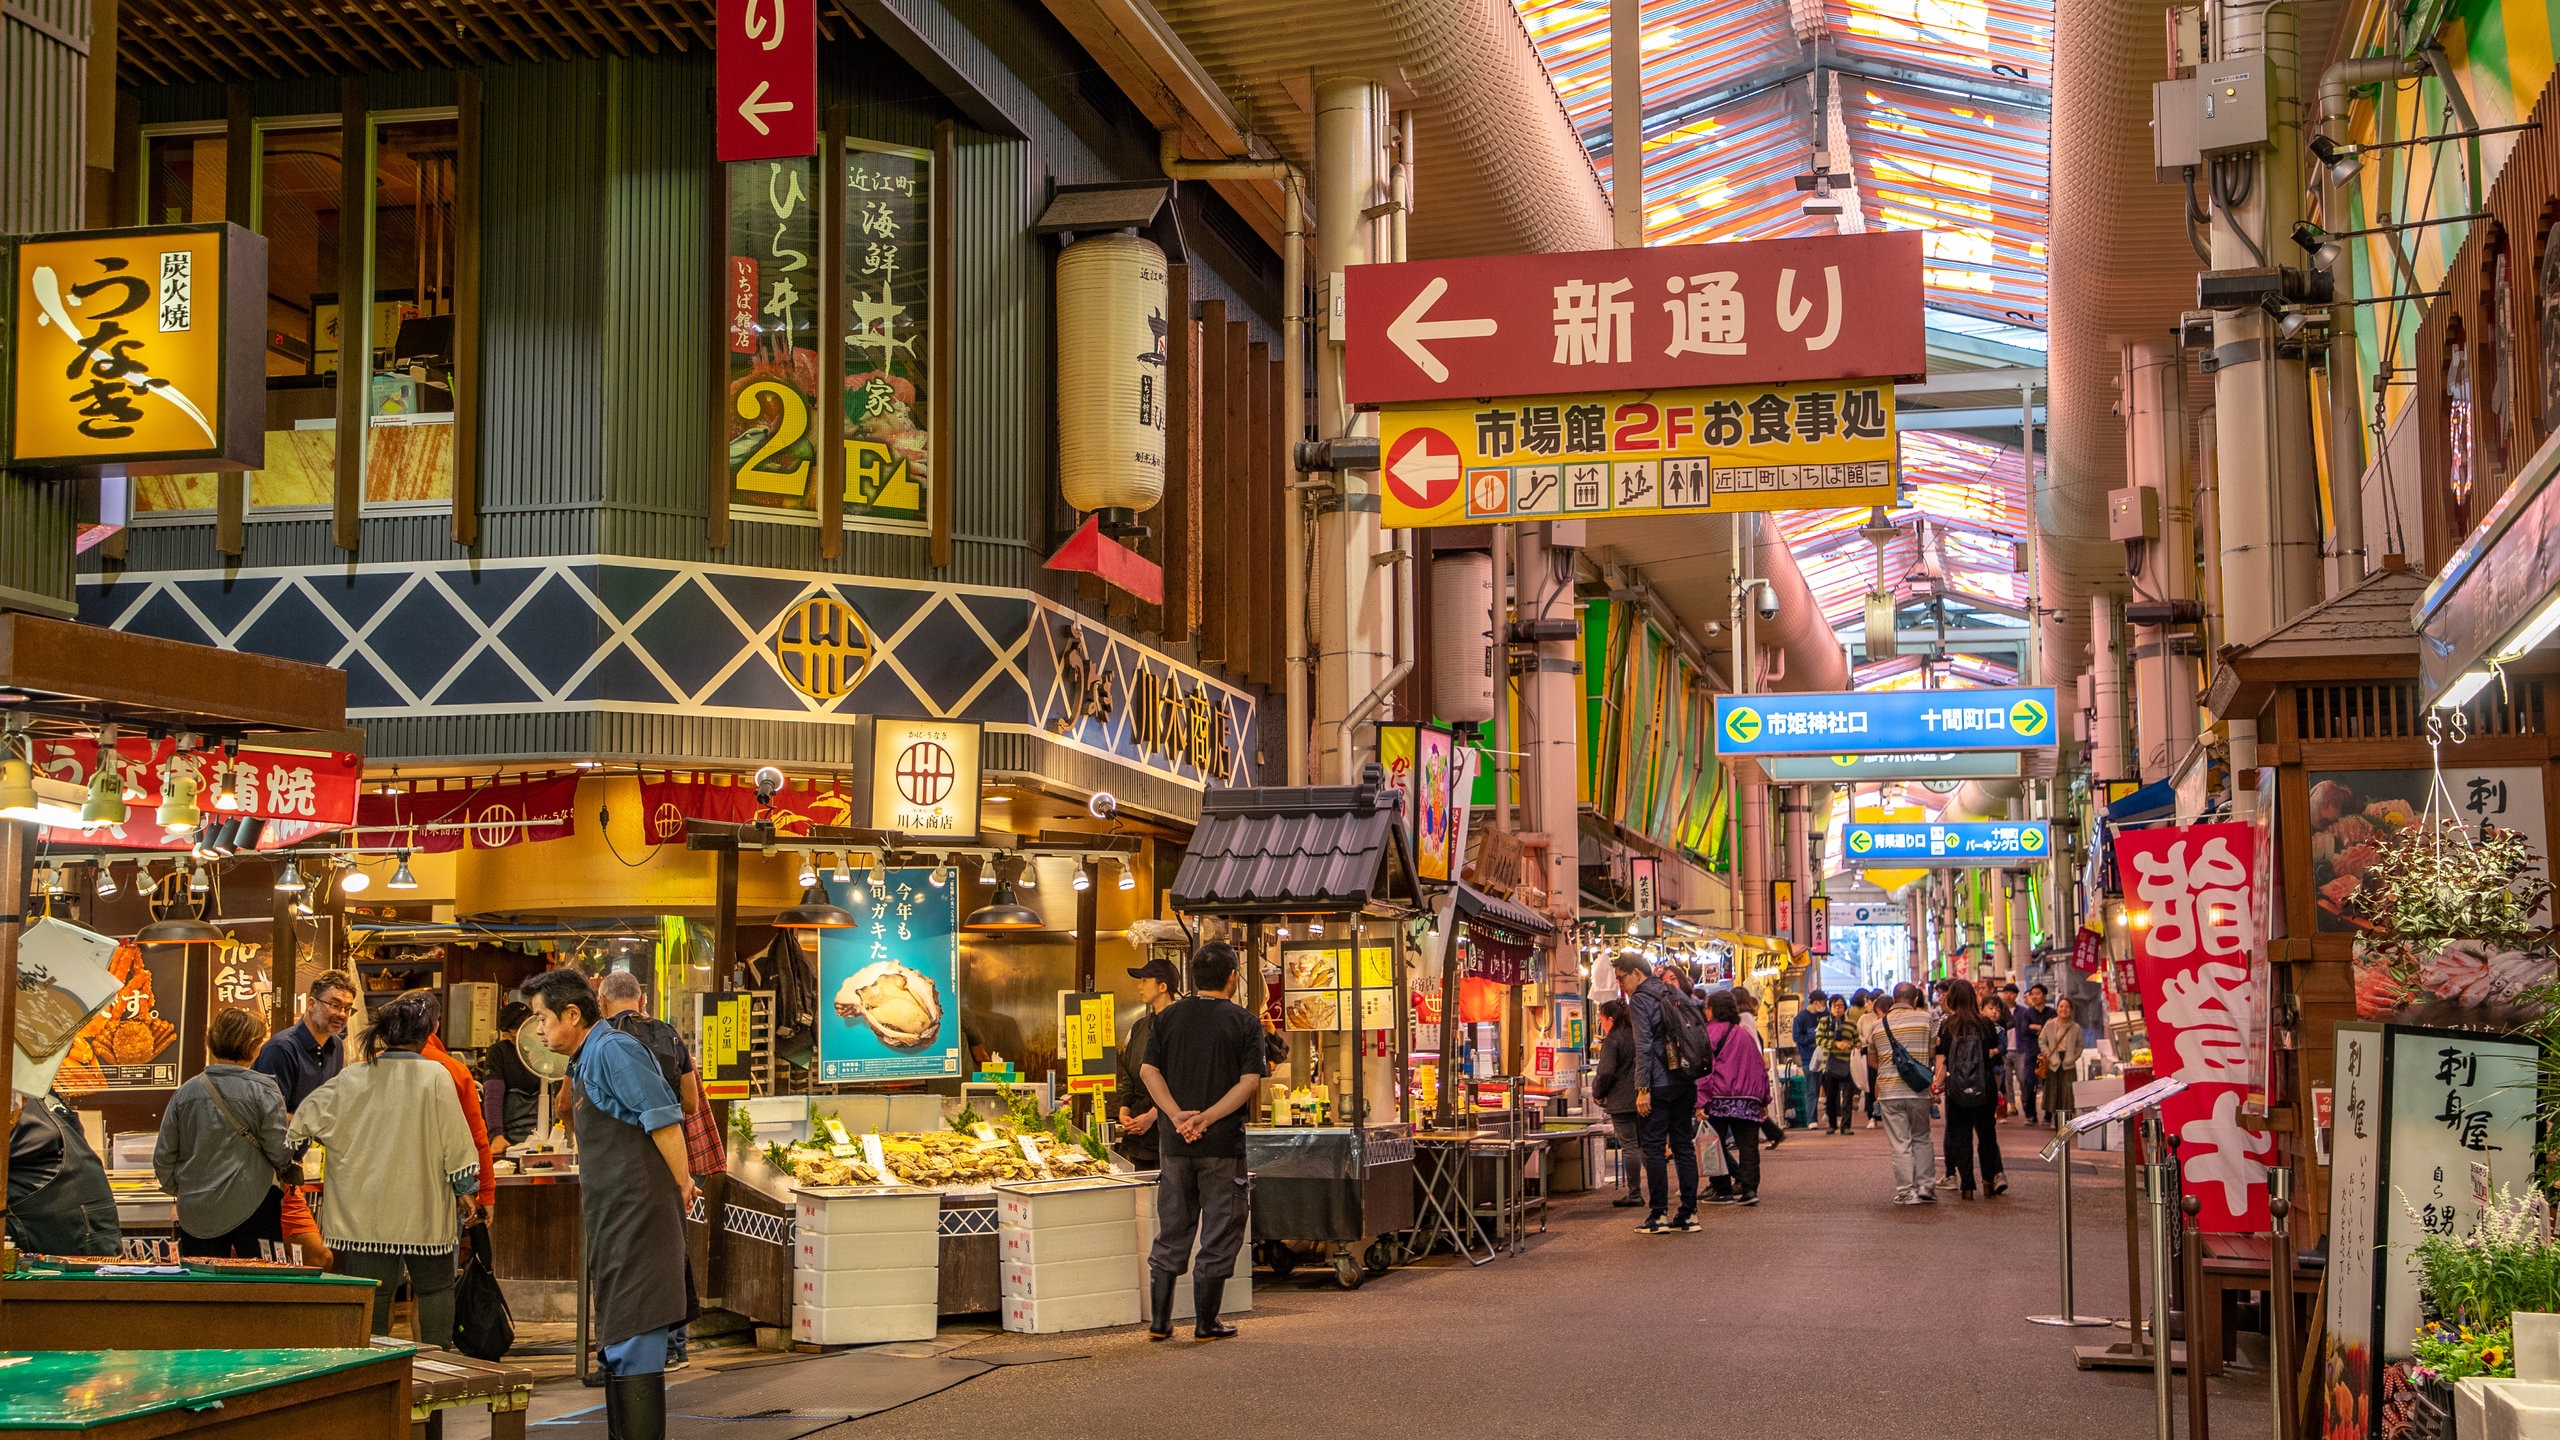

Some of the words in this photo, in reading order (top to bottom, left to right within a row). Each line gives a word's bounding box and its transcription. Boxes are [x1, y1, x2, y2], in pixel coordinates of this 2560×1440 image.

[847, 166, 917, 198] 近江町
[161, 254, 190, 330] 炭火焼
[733, 261, 753, 348] いちば館店
[1551, 264, 1845, 368] 新通り
[66, 256, 171, 440] うなぎ
[1136, 667, 1232, 780] 川木商店
[1766, 710, 1869, 737] 市姫神社口
[1919, 707, 2006, 733] 十間町口
[897, 814, 954, 830] 川木商店
[895, 882, 913, 941] 今年も
[721, 1015, 733, 1050] のど黒
[1085, 1013, 1097, 1045] のど黒
[2347, 1038, 2368, 1140] 刺身屋
[2434, 1045, 2504, 1152] 刺身屋
